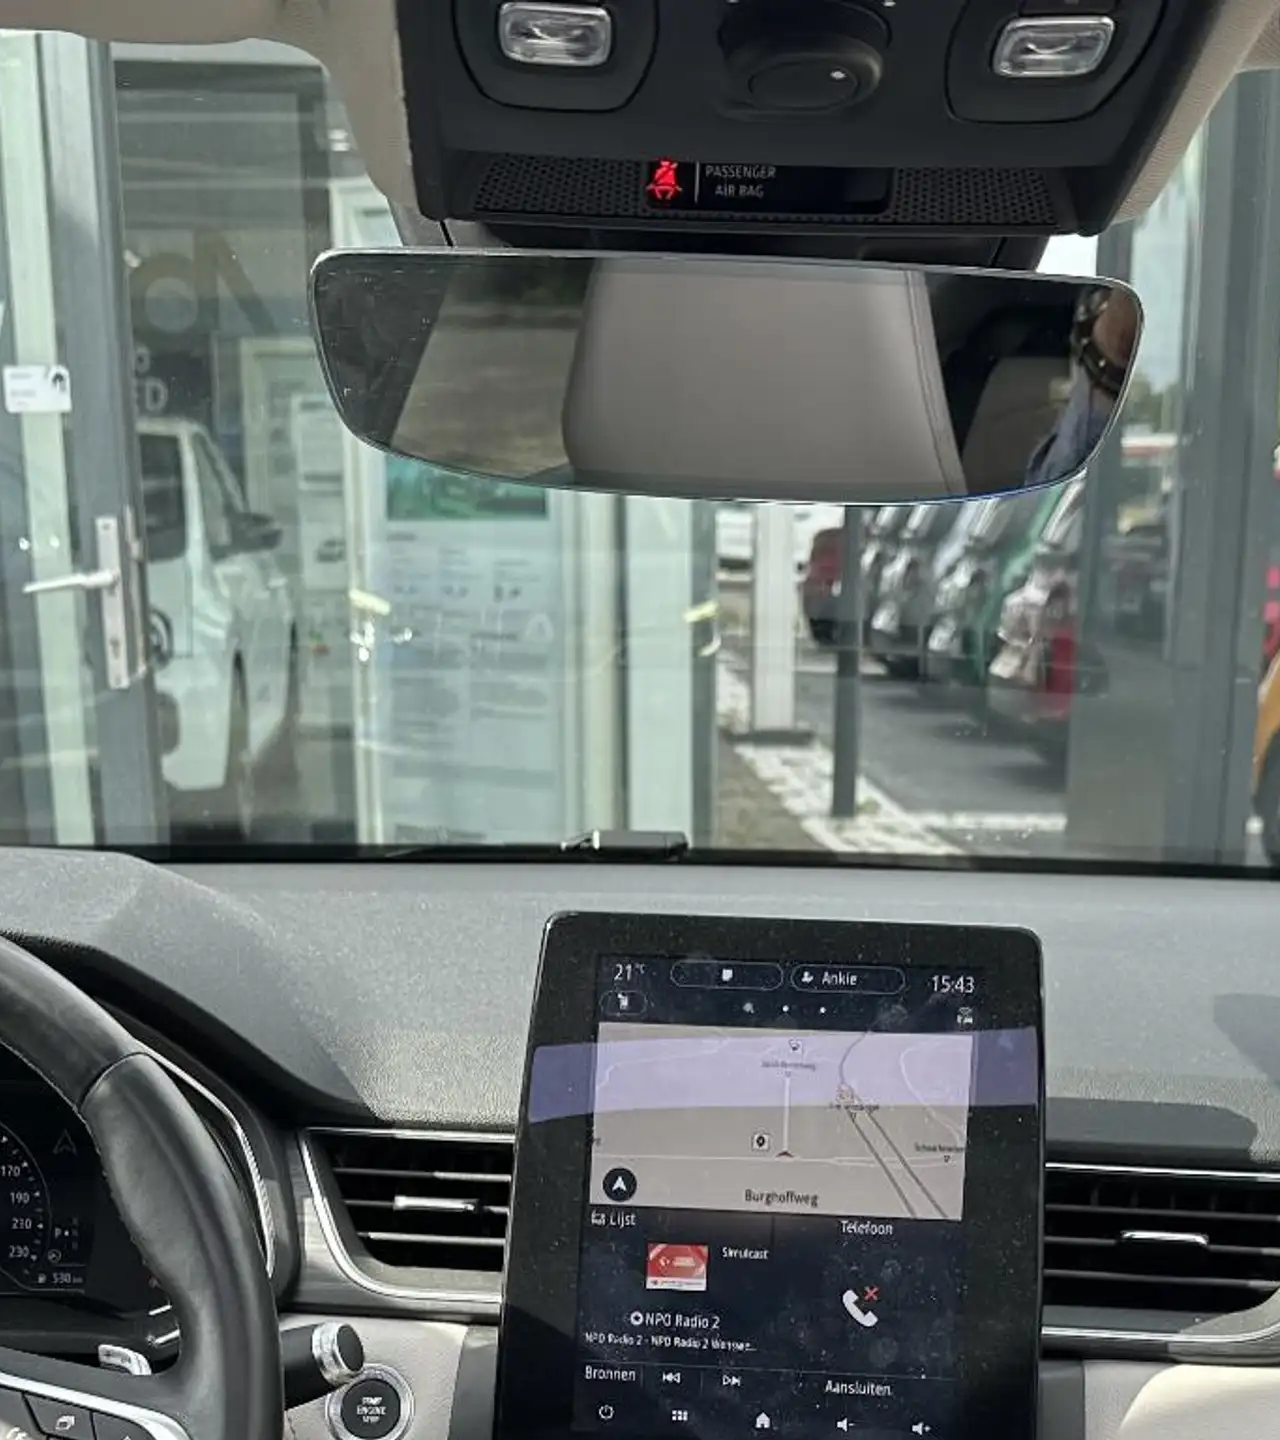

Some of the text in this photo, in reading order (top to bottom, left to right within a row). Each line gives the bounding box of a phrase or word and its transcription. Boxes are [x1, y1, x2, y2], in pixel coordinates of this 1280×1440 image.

[705, 165, 776, 179] PASSENGER
[715, 184, 765, 198] AIR BAG
[931, 974, 975, 994] 15:43
[0, 1164, 21, 1177] 170
[9, 1191, 30, 1204] 190
[744, 1188, 819, 1209] Burghoffweg
[11, 1217, 32, 1230] 210
[841, 1220, 893, 1236] Telefoon
[9, 1244, 30, 1258] 230
[645, 1314, 720, 1329] NPO Radio 2
[585, 1365, 636, 1382] Bronnen
[825, 1379, 892, 1396] Aansluiten
